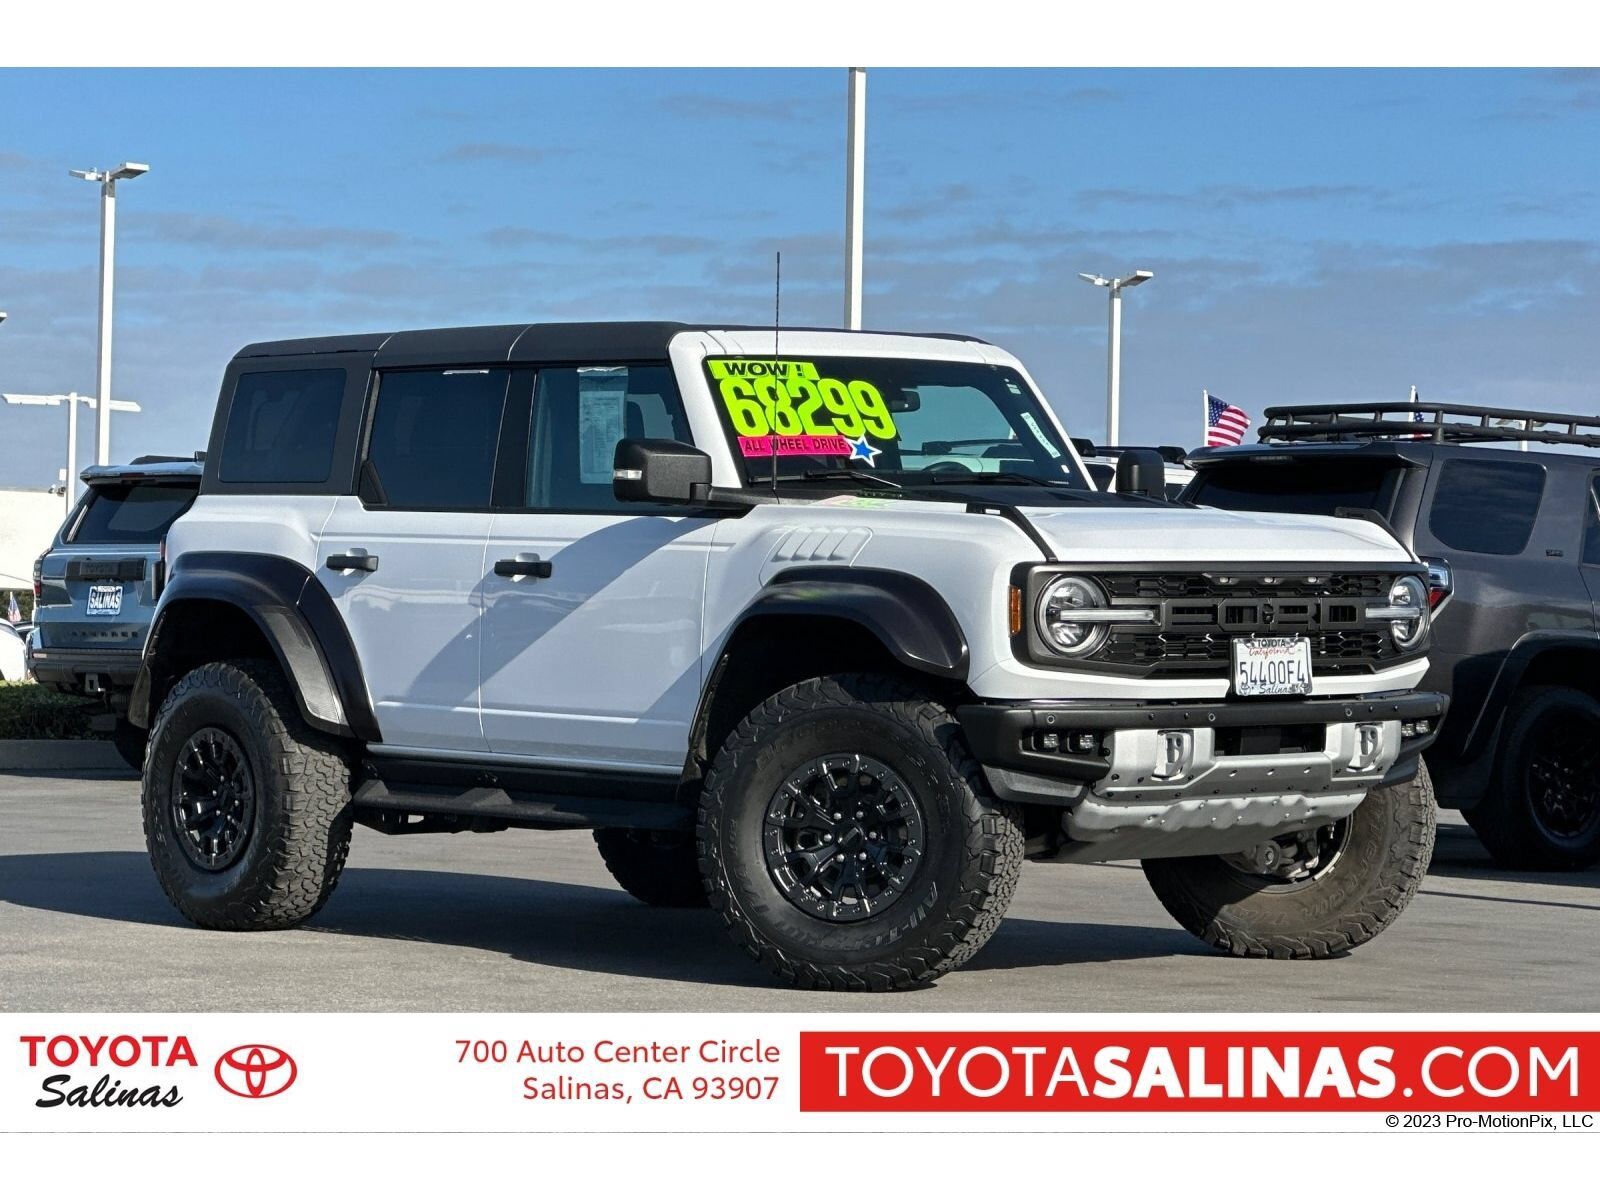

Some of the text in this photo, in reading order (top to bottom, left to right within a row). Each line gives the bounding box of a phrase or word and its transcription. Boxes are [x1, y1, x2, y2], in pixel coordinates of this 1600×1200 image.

[720, 377, 897, 439] 68299
[744, 438, 766, 452] ALL
[812, 436, 847, 451] DRIVE
[89, 591, 121, 609] SALINAS
[1257, 638, 1286, 647] TOYOTA
[1239, 660, 1306, 686] 54400F4
